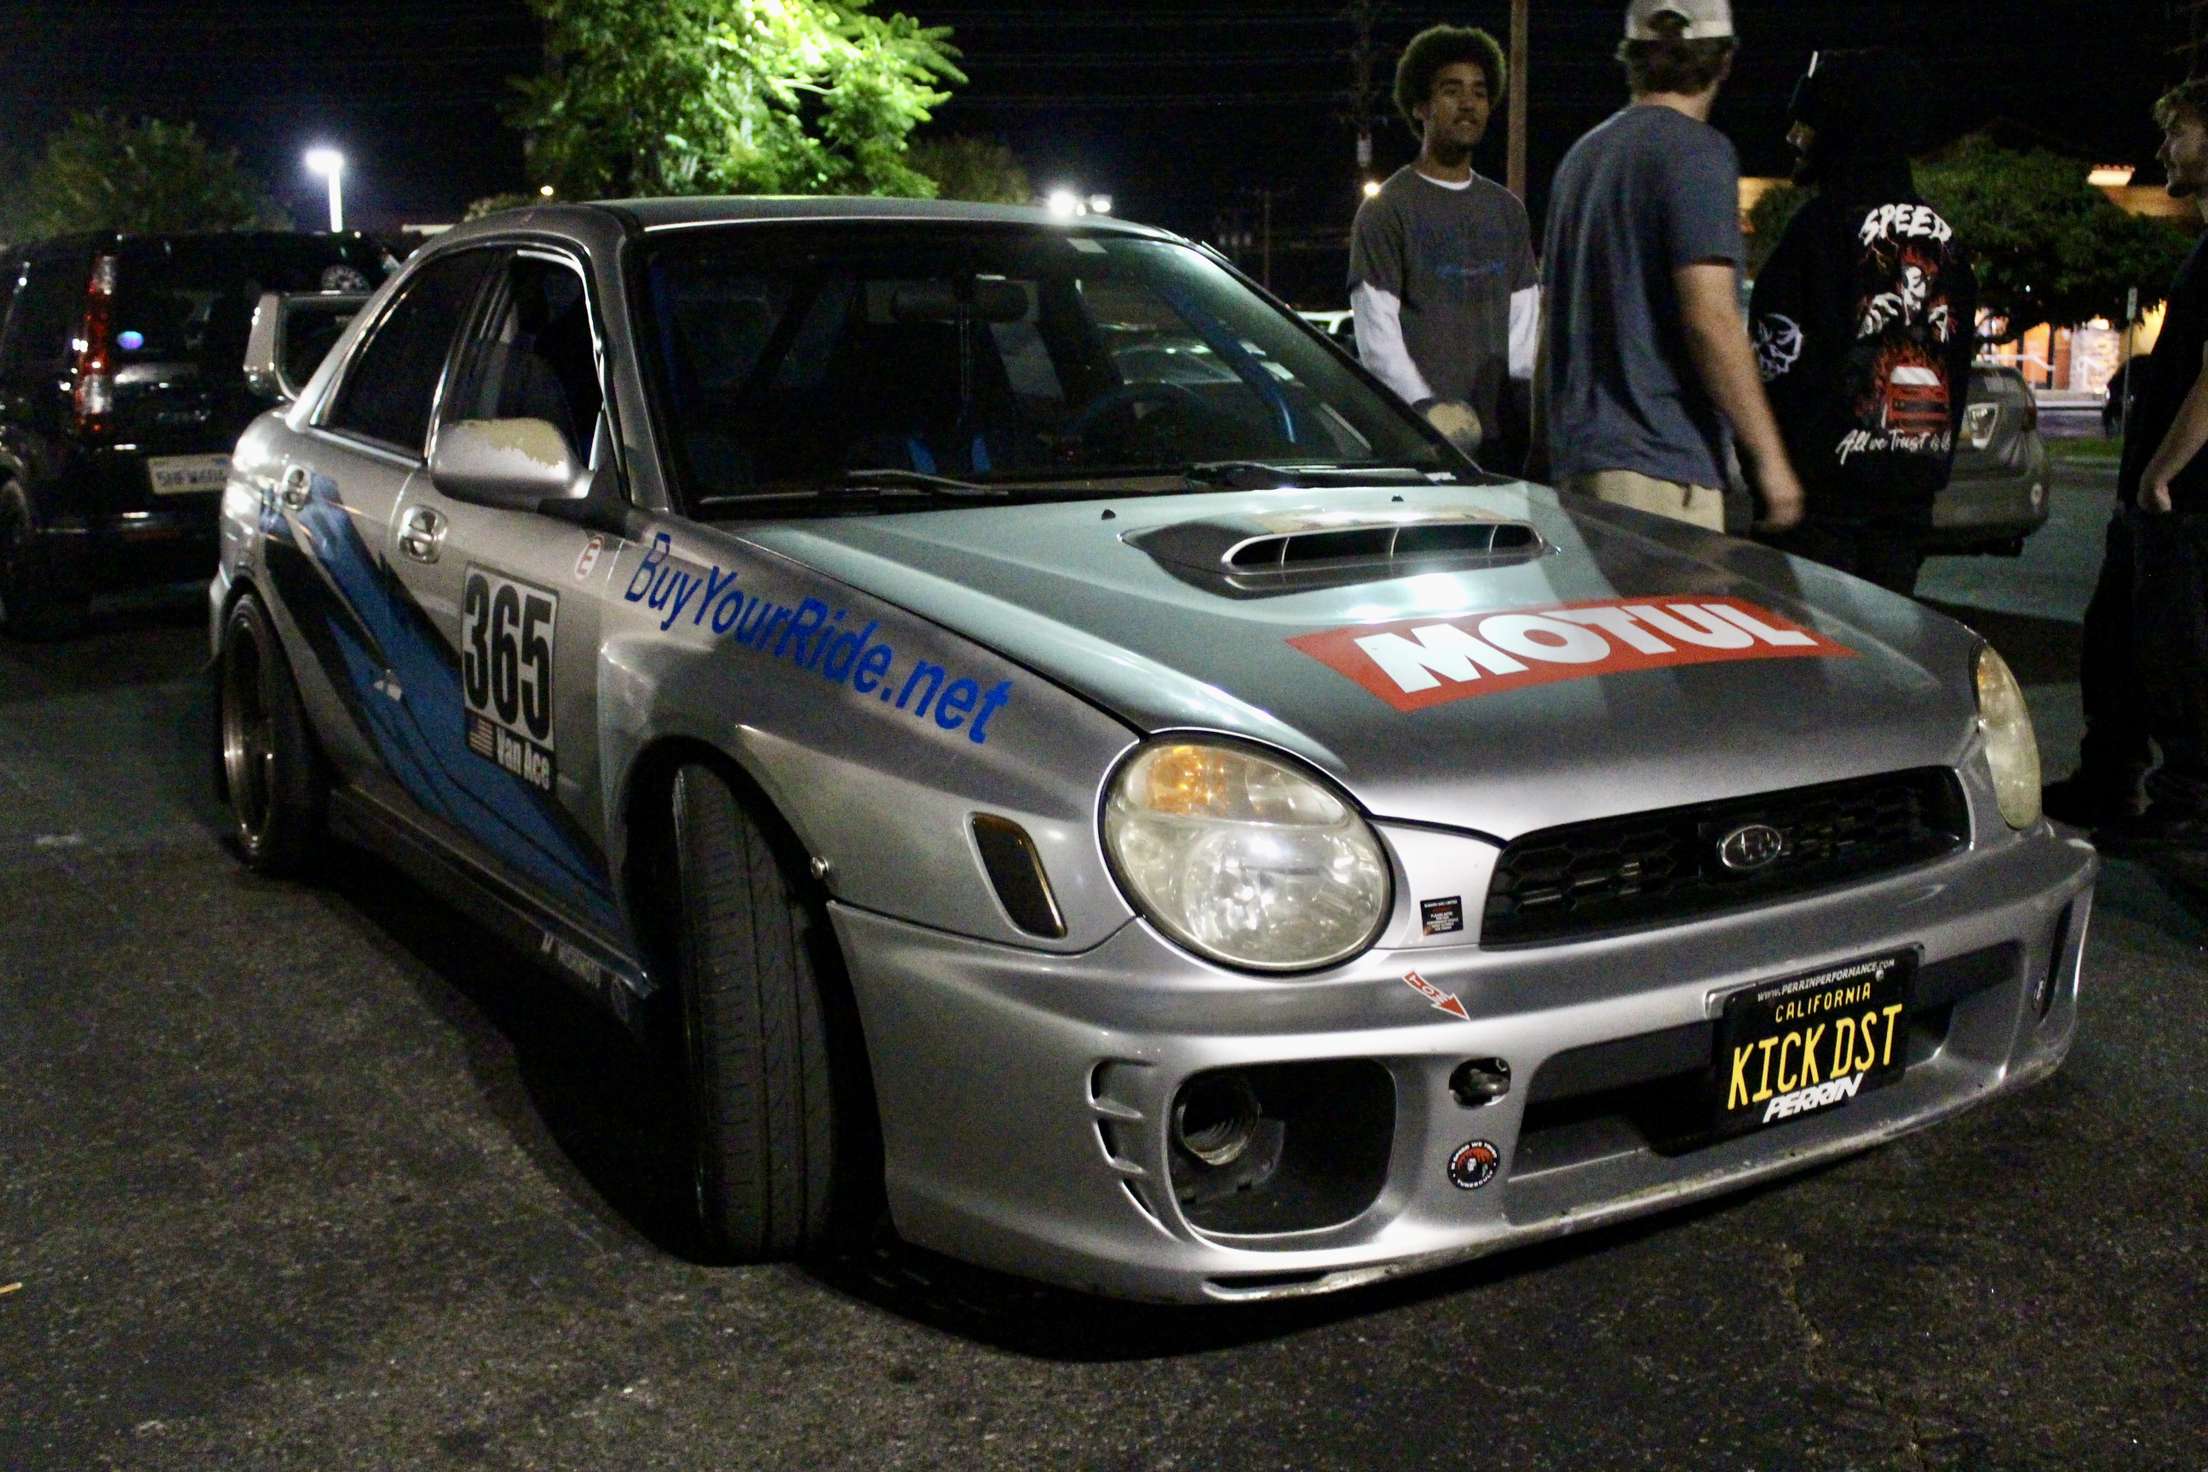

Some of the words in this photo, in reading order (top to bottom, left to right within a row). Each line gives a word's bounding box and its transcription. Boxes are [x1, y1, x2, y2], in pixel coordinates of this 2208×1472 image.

[1858, 203, 1953, 246] SPEED
[1834, 429, 1872, 466] All
[464, 573, 552, 741] 365
[625, 531, 1013, 744] BuyYourRide.net
[1353, 603, 1819, 694] MOTUL
[496, 726, 523, 776] Van
[1775, 982, 1872, 1023] CALIFORNIA
[1762, 1072, 1864, 1124] PERRIN
